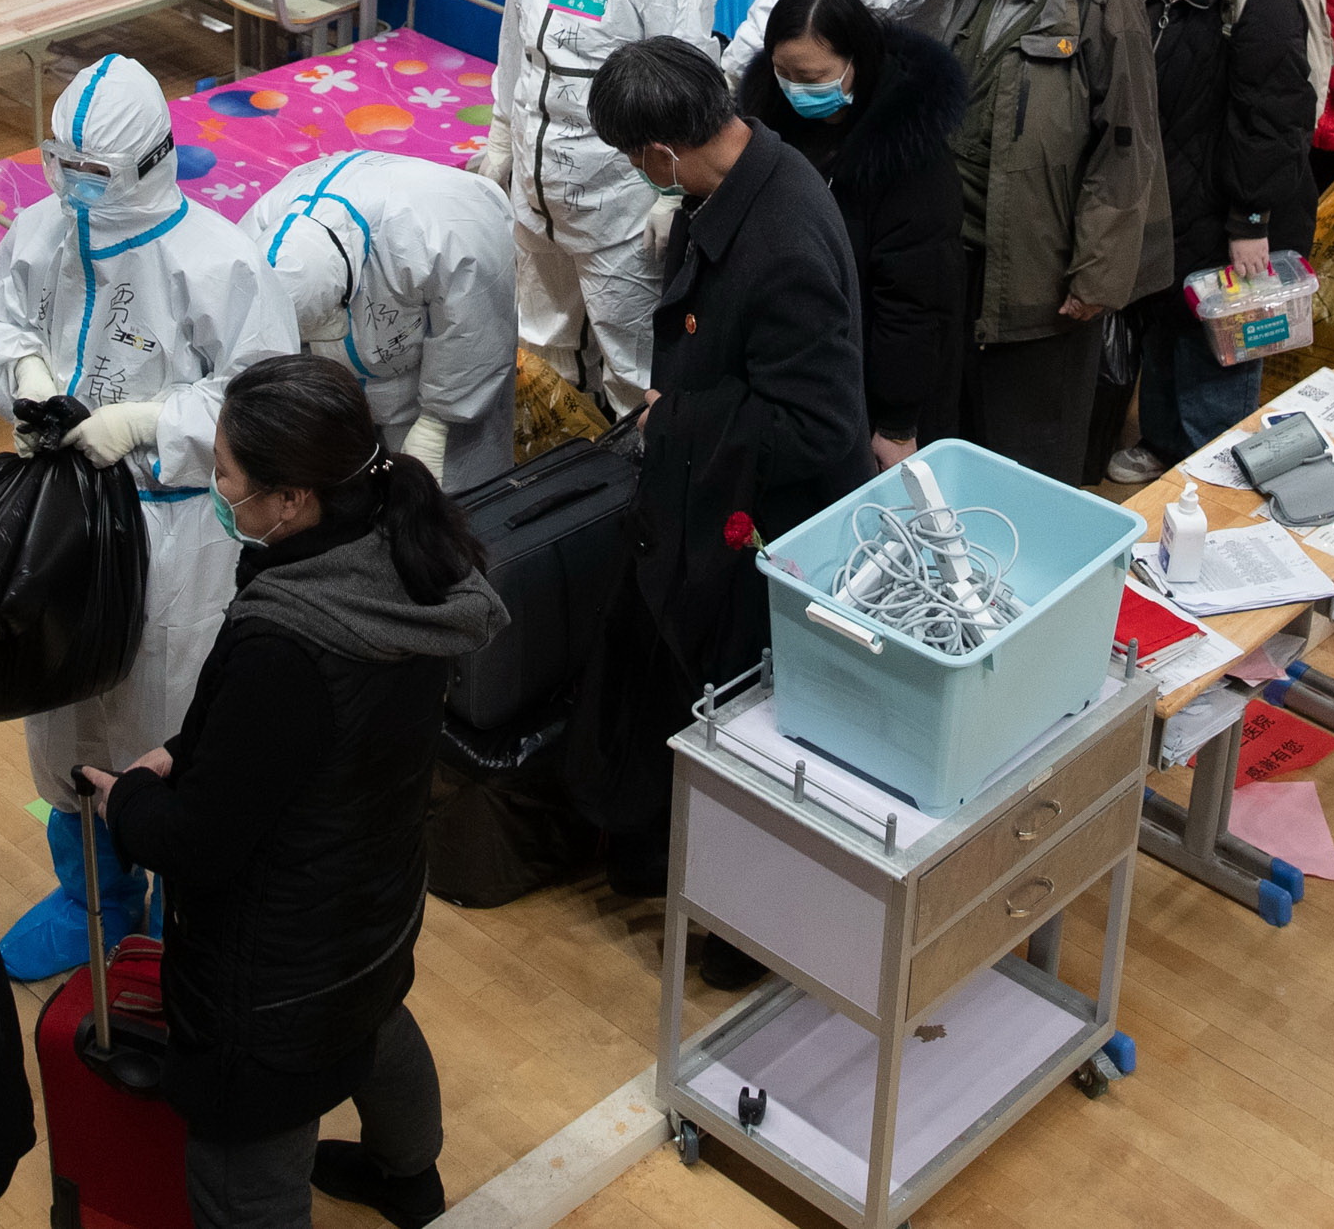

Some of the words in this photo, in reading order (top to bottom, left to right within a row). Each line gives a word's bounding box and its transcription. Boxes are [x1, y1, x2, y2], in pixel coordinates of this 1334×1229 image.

[111, 327, 157, 353] 3502
[1245, 738, 1305, 781] 感谢有您
